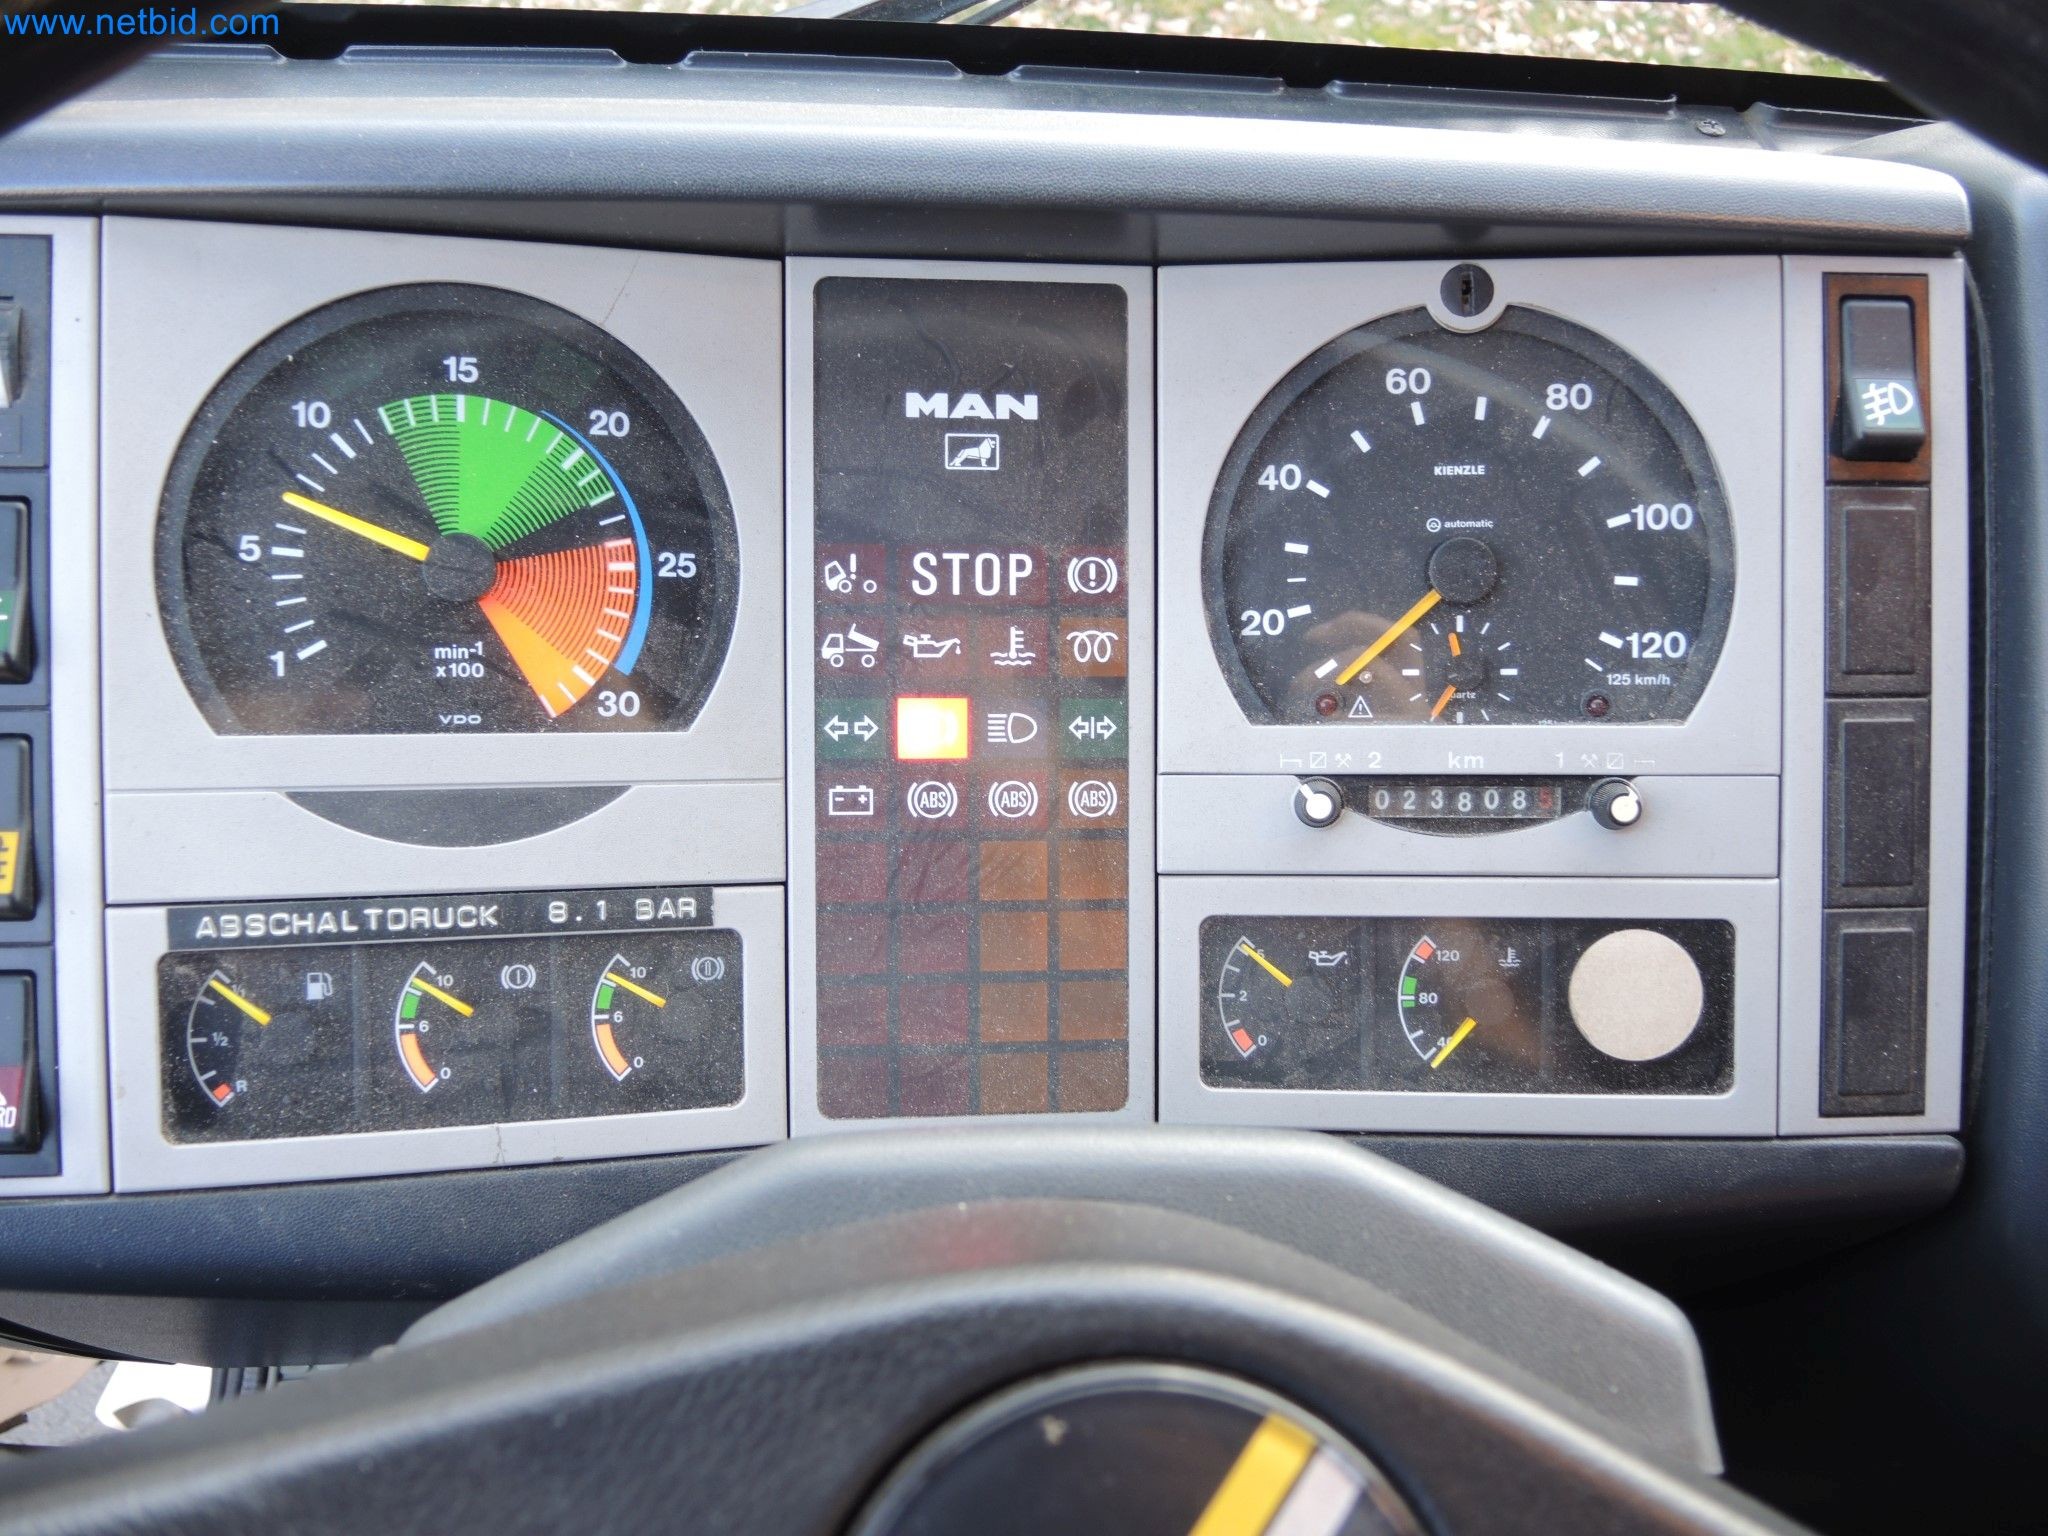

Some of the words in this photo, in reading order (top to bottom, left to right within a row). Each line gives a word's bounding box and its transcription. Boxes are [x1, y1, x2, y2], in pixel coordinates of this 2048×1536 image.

[443, 357, 479, 384] 15
[1385, 367, 1431, 395] 60
[1545, 383, 1592, 411] 80
[905, 392, 1039, 420] MAN
[293, 401, 331, 429] 10
[589, 410, 630, 438] 20
[1258, 464, 1302, 491] 40
[1434, 465, 1486, 476] KIENZLE
[1444, 519, 1494, 529] automatic
[1631, 504, 1693, 531] 100
[238, 535, 260, 562] 5
[658, 551, 697, 579] 25
[911, 552, 1034, 597] STOP
[1240, 609, 1285, 637] 20
[1626, 632, 1686, 659] 120
[270, 651, 285, 677] 1
[1606, 673, 1632, 685] 125
[1634, 672, 1670, 686] km/h
[598, 691, 641, 718] 30
[439, 714, 482, 724] VDO
[1368, 752, 1381, 769] 2
[1448, 752, 1484, 769] km
[1555, 752, 1564, 769] 1
[920, 791, 946, 808] ABS
[1000, 791, 1026, 808] ABS
[1080, 790, 1106, 807] ABS
[636, 897, 697, 920] BAR
[1436, 949, 1460, 961] 120
[436, 974, 454, 987] 10
[629, 966, 647, 979] 10
[1240, 990, 1247, 1001] 2
[1419, 992, 1438, 1005] 80
[613, 1010, 623, 1023] 6
[419, 1019, 429, 1033] 6
[1258, 1034, 1267, 1046] 0
[633, 1056, 644, 1069] 0
[440, 1066, 451, 1079] 0
[236, 1080, 248, 1093] R
